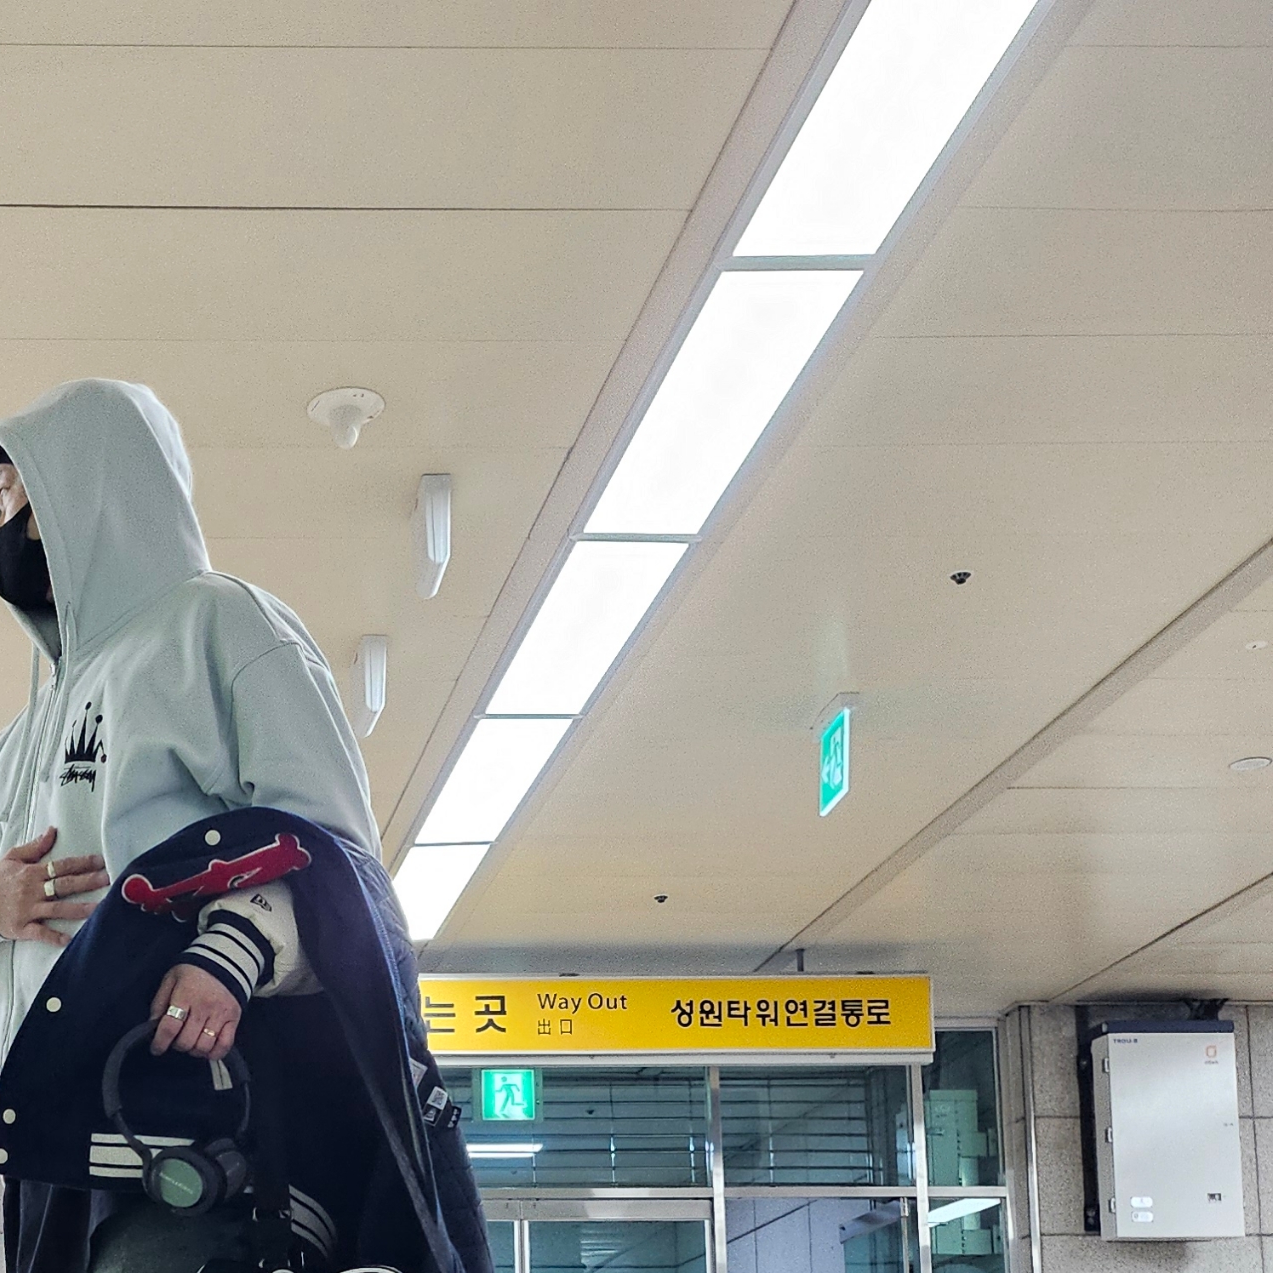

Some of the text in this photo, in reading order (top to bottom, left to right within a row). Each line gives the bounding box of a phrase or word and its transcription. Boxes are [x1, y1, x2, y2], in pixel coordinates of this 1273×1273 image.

[537, 993, 628, 1014] Way Out
[670, 999, 891, 1028] 성원타워연결통로
[537, 1018, 573, 1036] 出口
